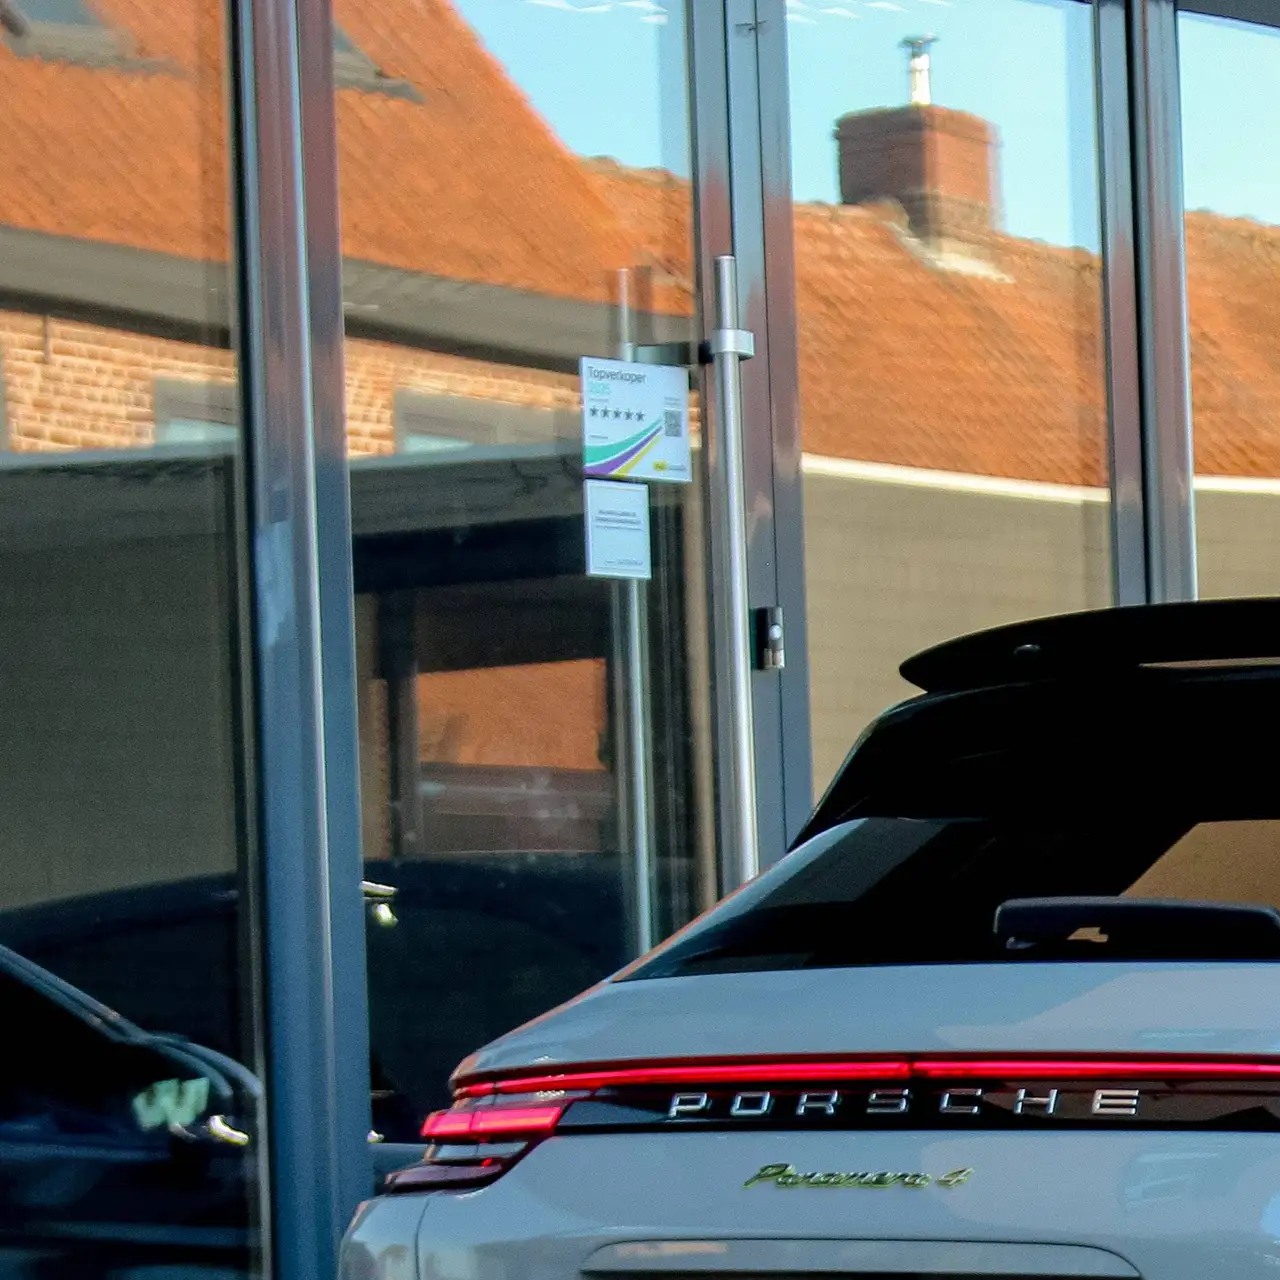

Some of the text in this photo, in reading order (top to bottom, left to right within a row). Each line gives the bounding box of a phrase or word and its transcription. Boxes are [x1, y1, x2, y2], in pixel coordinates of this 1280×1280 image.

[588, 366, 647, 383] Topverkoper
[668, 1087, 1140, 1119] PORSCHE
[742, 1162, 975, 1188] Panamera 4
